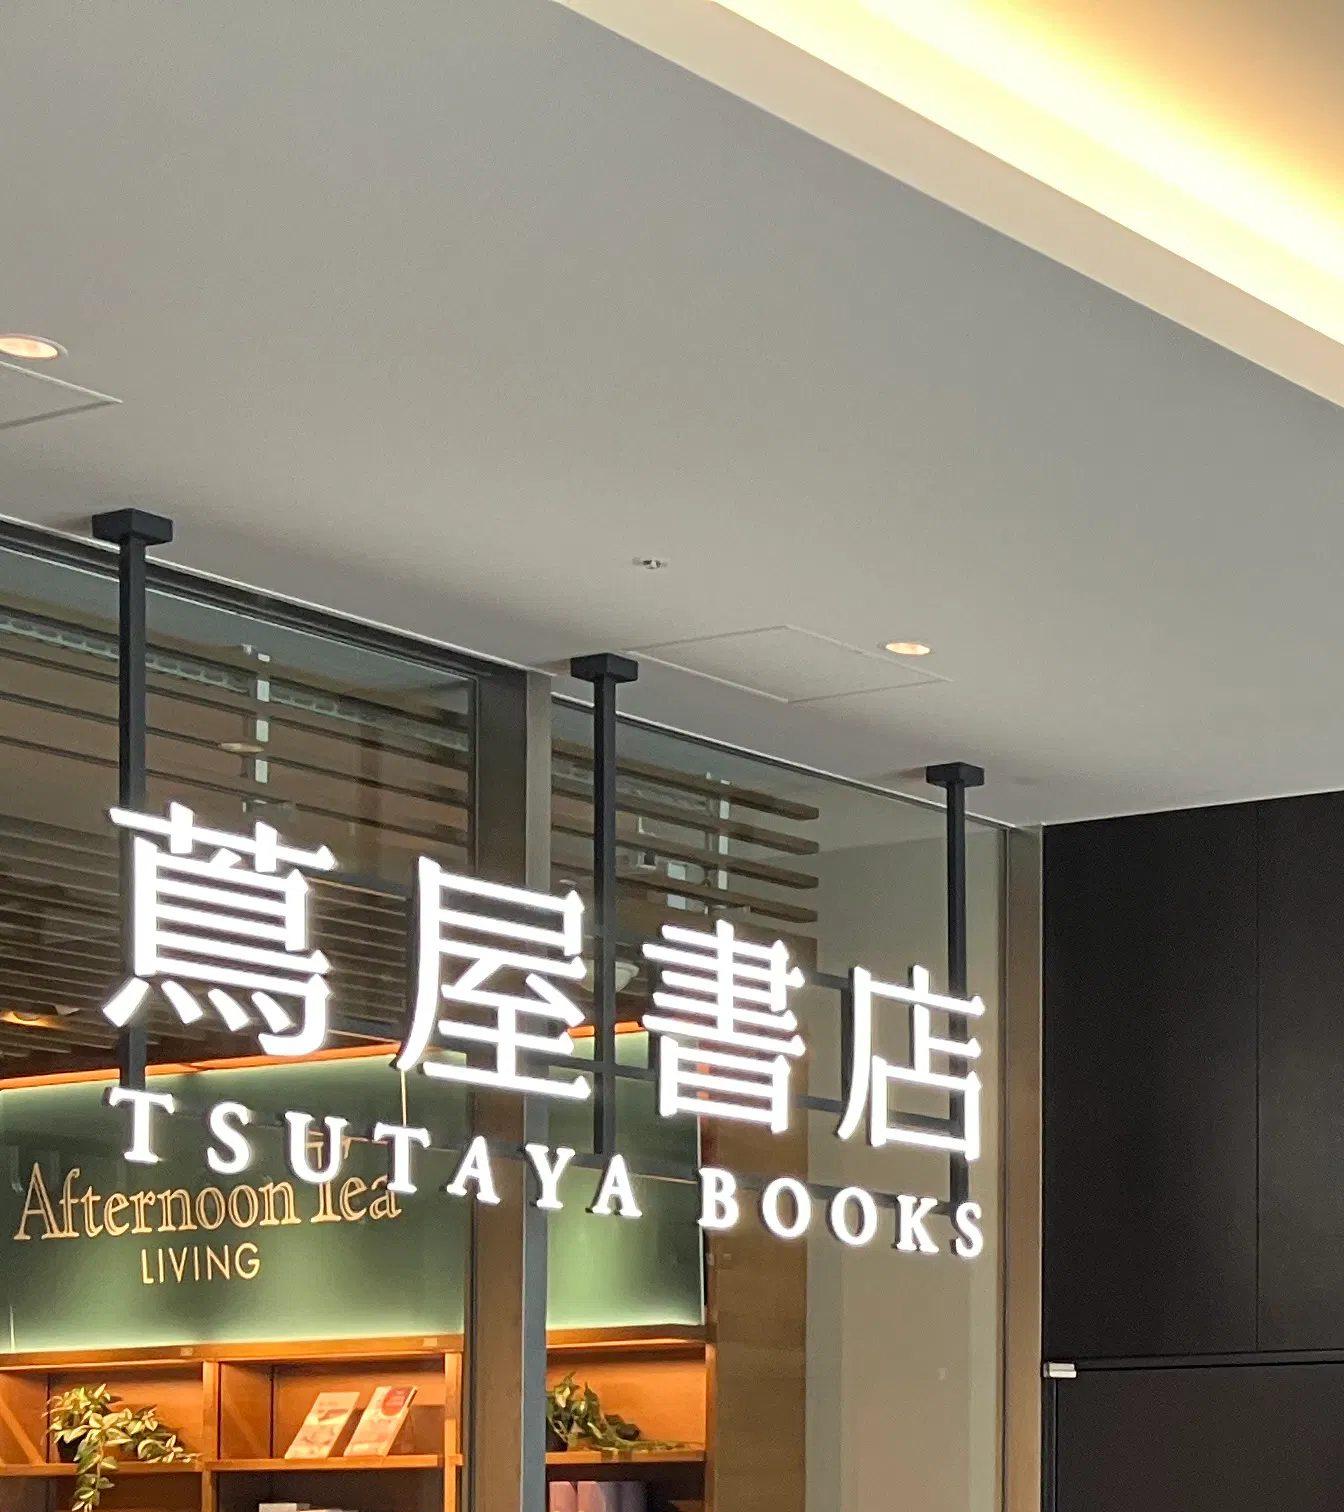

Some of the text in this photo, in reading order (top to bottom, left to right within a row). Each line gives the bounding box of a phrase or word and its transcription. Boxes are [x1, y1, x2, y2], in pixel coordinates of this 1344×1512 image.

[103, 803, 985, 1162] 蔦屋書店
[13, 1161, 301, 1240] Afternoon
[109, 1088, 985, 1258] TSUTAYA BOOKS
[140, 1242, 262, 1285] LIVING
